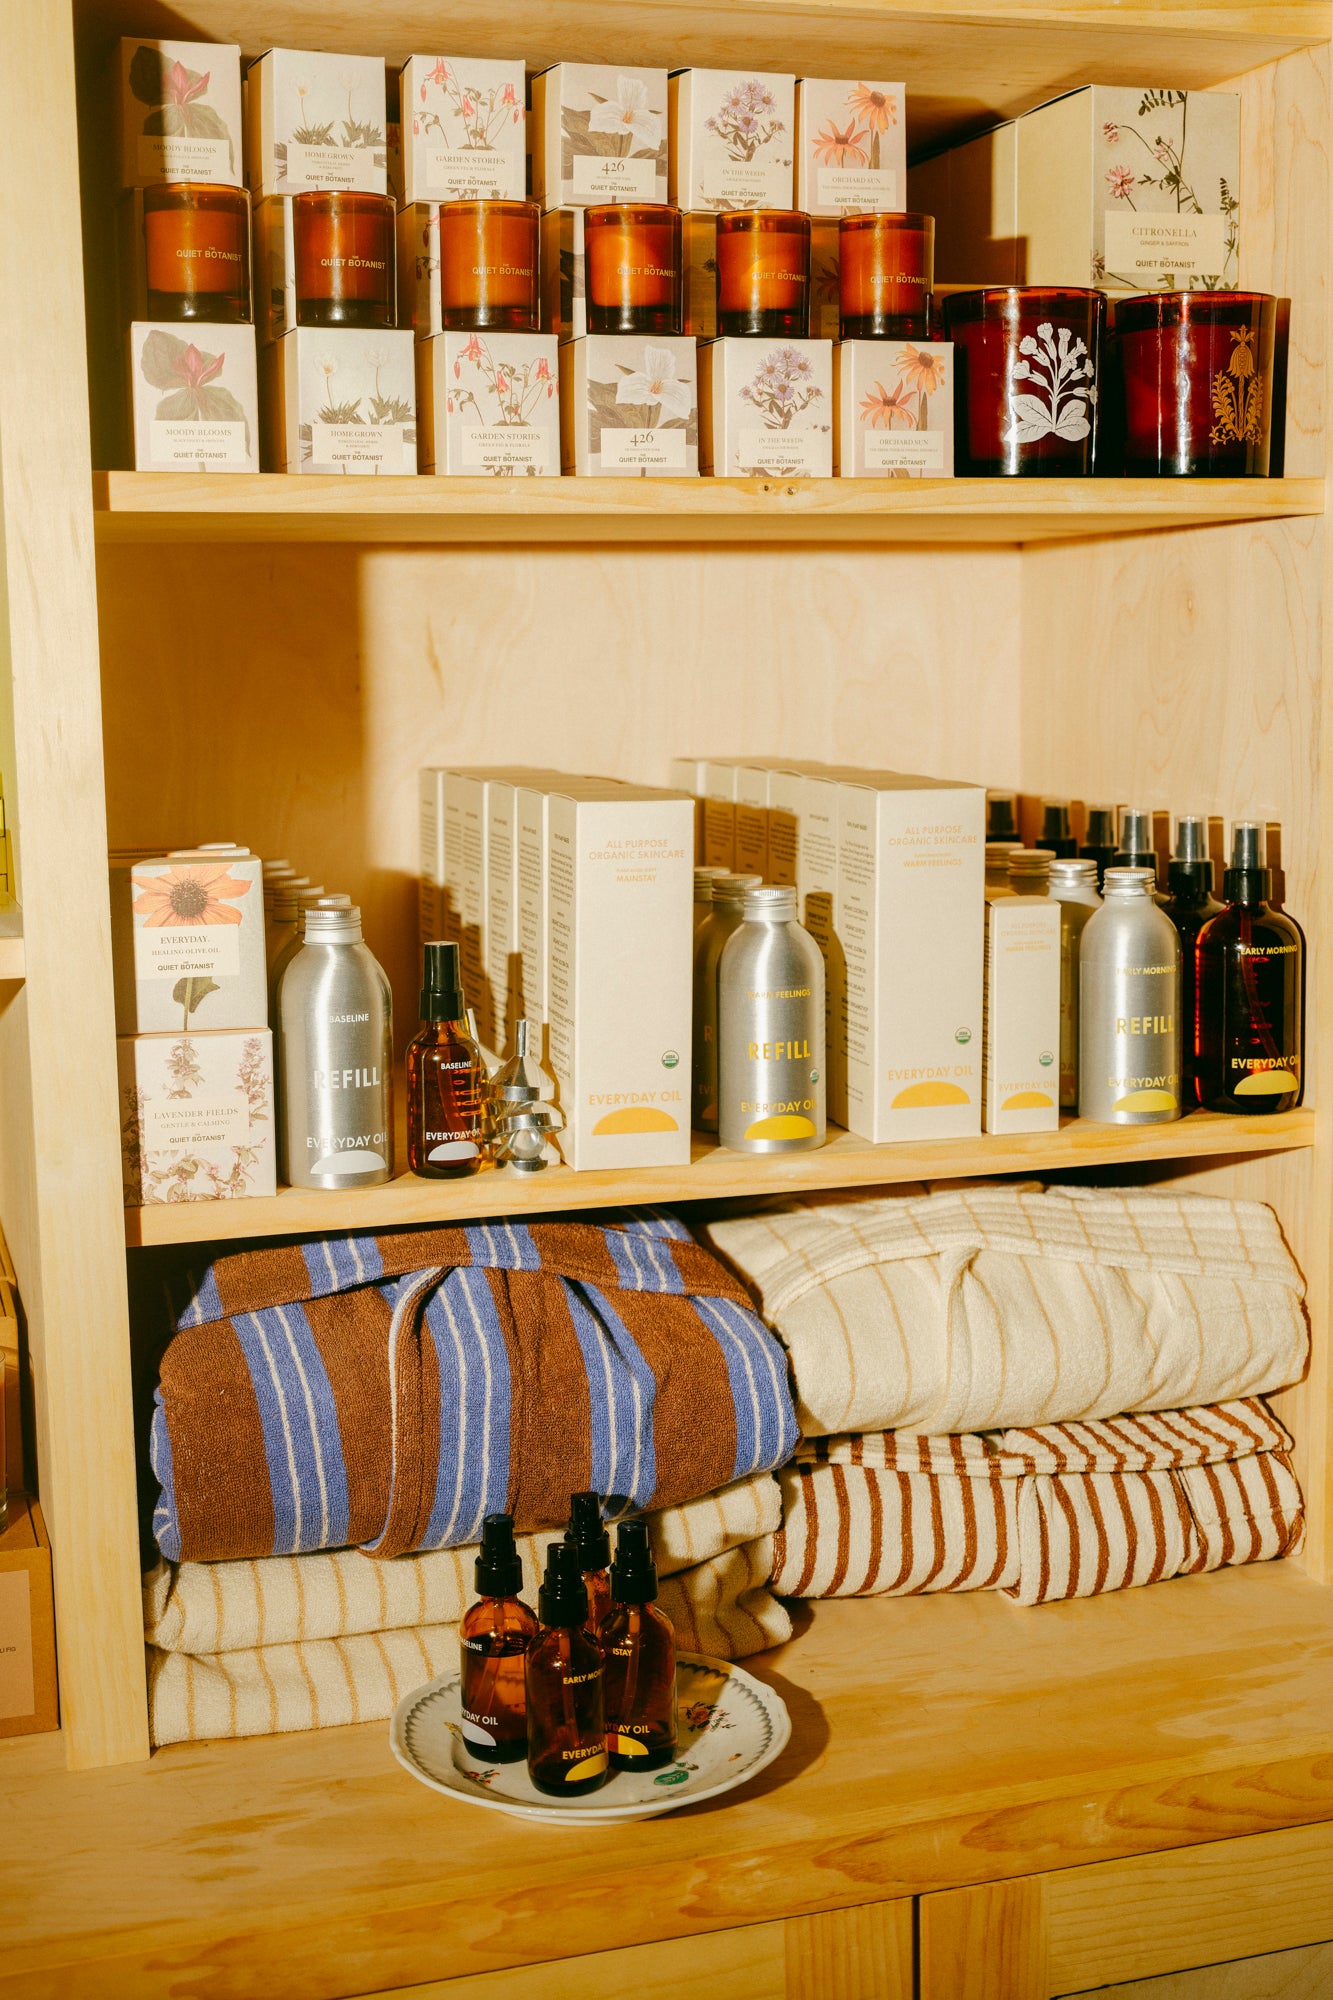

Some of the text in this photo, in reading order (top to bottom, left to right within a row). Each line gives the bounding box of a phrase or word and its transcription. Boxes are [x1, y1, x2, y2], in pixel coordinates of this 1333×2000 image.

[436, 155, 506, 165] GARDEN STORIES
[601, 159, 625, 175] 426
[325, 175, 355, 183] BOTANIST
[1132, 227, 1198, 239] CITRONELLA
[176, 249, 242, 262] QUIET BOTANIST
[320, 258, 386, 270] QUIET BOTANIST
[1159, 260, 1196, 269] BOTANIST
[472, 266, 534, 277] QUIET BOTANIST
[166, 428, 232, 437] MOODY BLOOMS
[506, 433, 541, 441] STORIES
[629, 430, 654, 447] 426
[904, 825, 962, 834] ALL PURPOSE
[607, 839, 668, 849] ALL PURPOSE
[888, 835, 977, 846] ORGANIC SKINCARE
[588, 849, 685, 861] ORGANIC SKINCARE
[616, 874, 657, 882] MAINSTAY
[160, 935, 209, 945] EVERYDAY
[1241, 944, 1298, 956] EARLY MORNING
[180, 962, 215, 971] BOTANIST
[776, 988, 812, 998] FEELINGS
[1116, 1014, 1175, 1035] REFILL
[748, 1039, 811, 1061] REFILL
[440, 1060, 472, 1070] BASELINE
[1231, 1056, 1289, 1069] EVERYDAY
[314, 1066, 381, 1089] REFILL
[887, 1065, 974, 1081] EVERYDAY OIL
[588, 1090, 682, 1106] EVERYDAY OIL
[741, 1100, 801, 1113] EVERYDAY
[154, 1107, 239, 1120] LAVENDER FIELDS
[160, 1121, 189, 1129] GENTLE
[197, 1119, 230, 1128] CALMING
[169, 1134, 226, 1144] QUIET BOTANIST
[425, 1130, 470, 1141] EVERYDAY
[562, 1674, 587, 1685] EARLY
[482, 1715, 499, 1726] OIL
[632, 1724, 651, 1734] OIL
